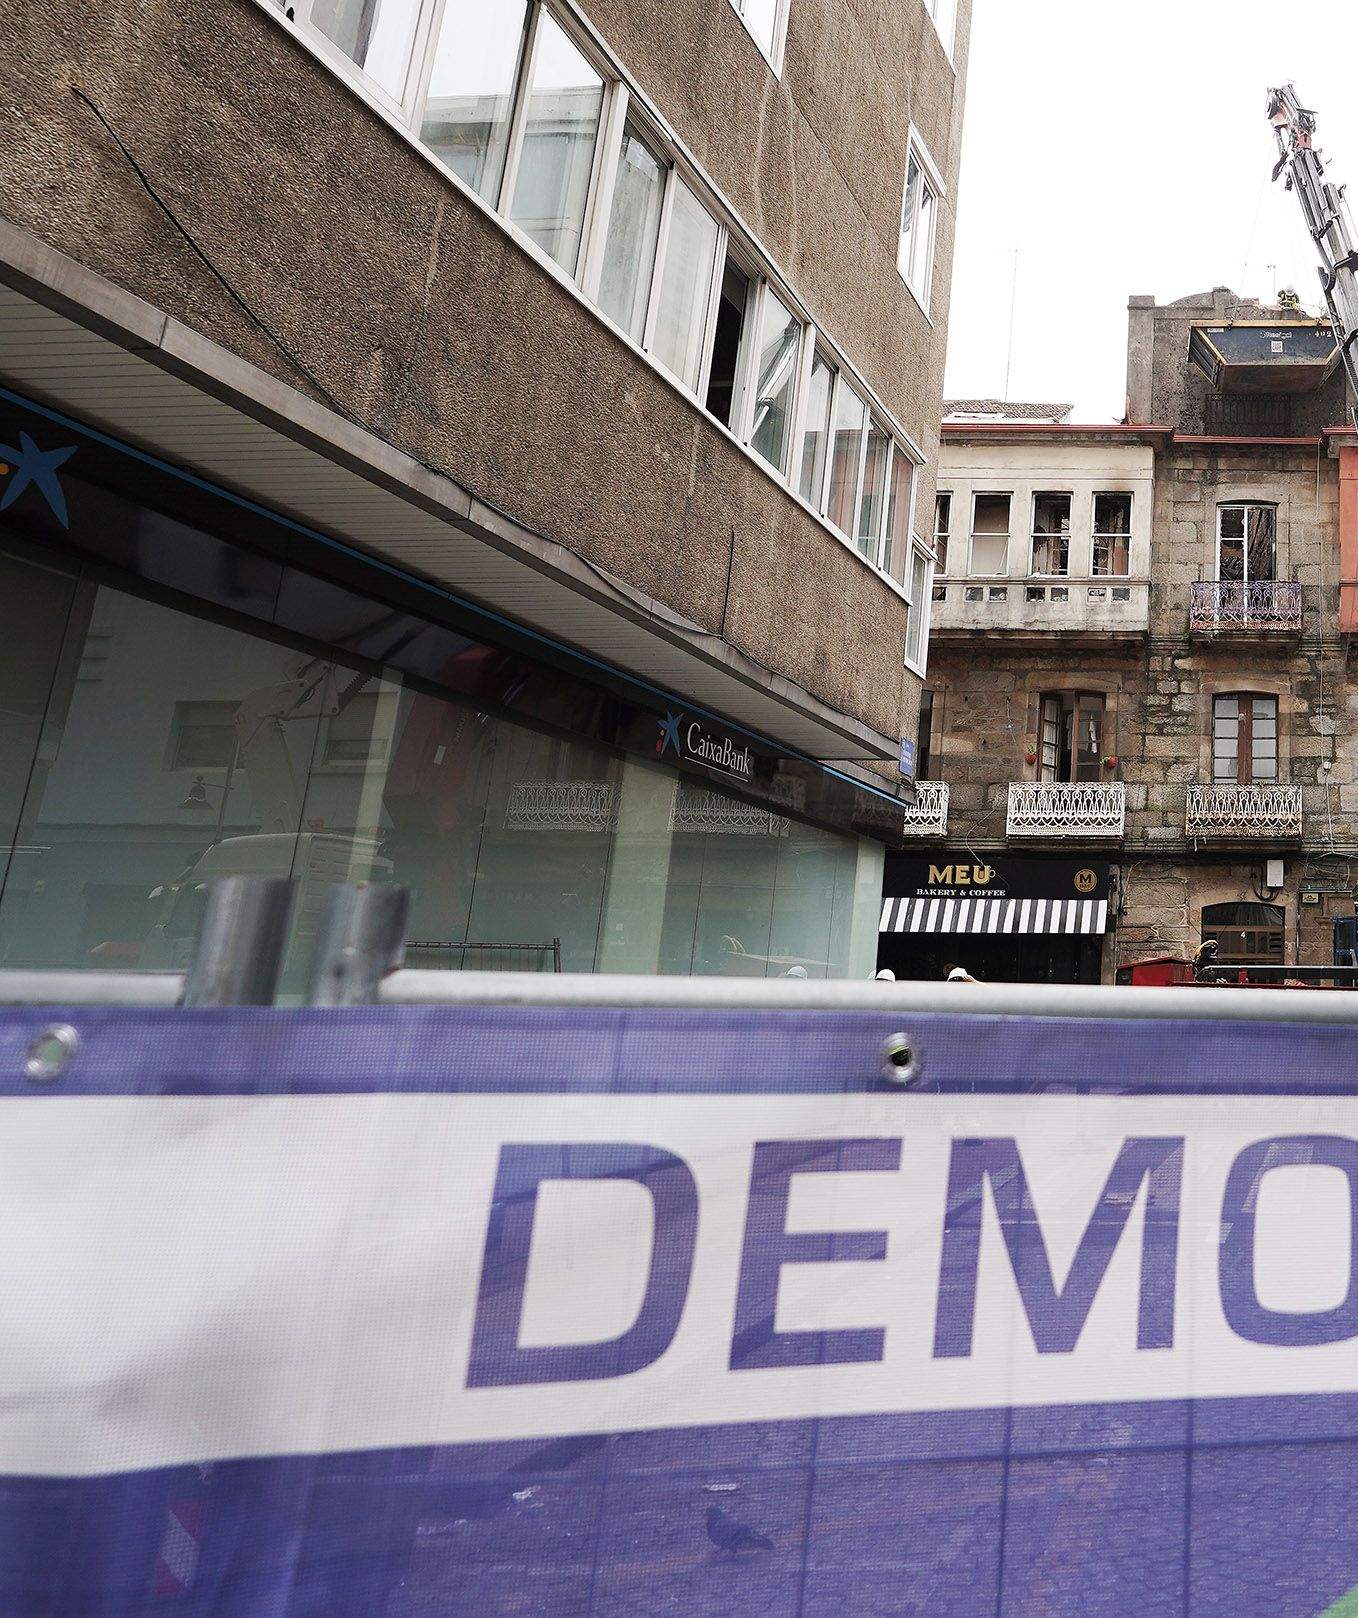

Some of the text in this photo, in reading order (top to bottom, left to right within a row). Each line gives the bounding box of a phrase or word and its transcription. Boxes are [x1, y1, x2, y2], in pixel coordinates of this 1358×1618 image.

[687, 722, 750, 775] CaixaBank
[927, 864, 994, 885] MEU
[1079, 873, 1092, 884] M
[916, 888, 956, 896] BAKERY
[969, 889, 1006, 897] COFFEE
